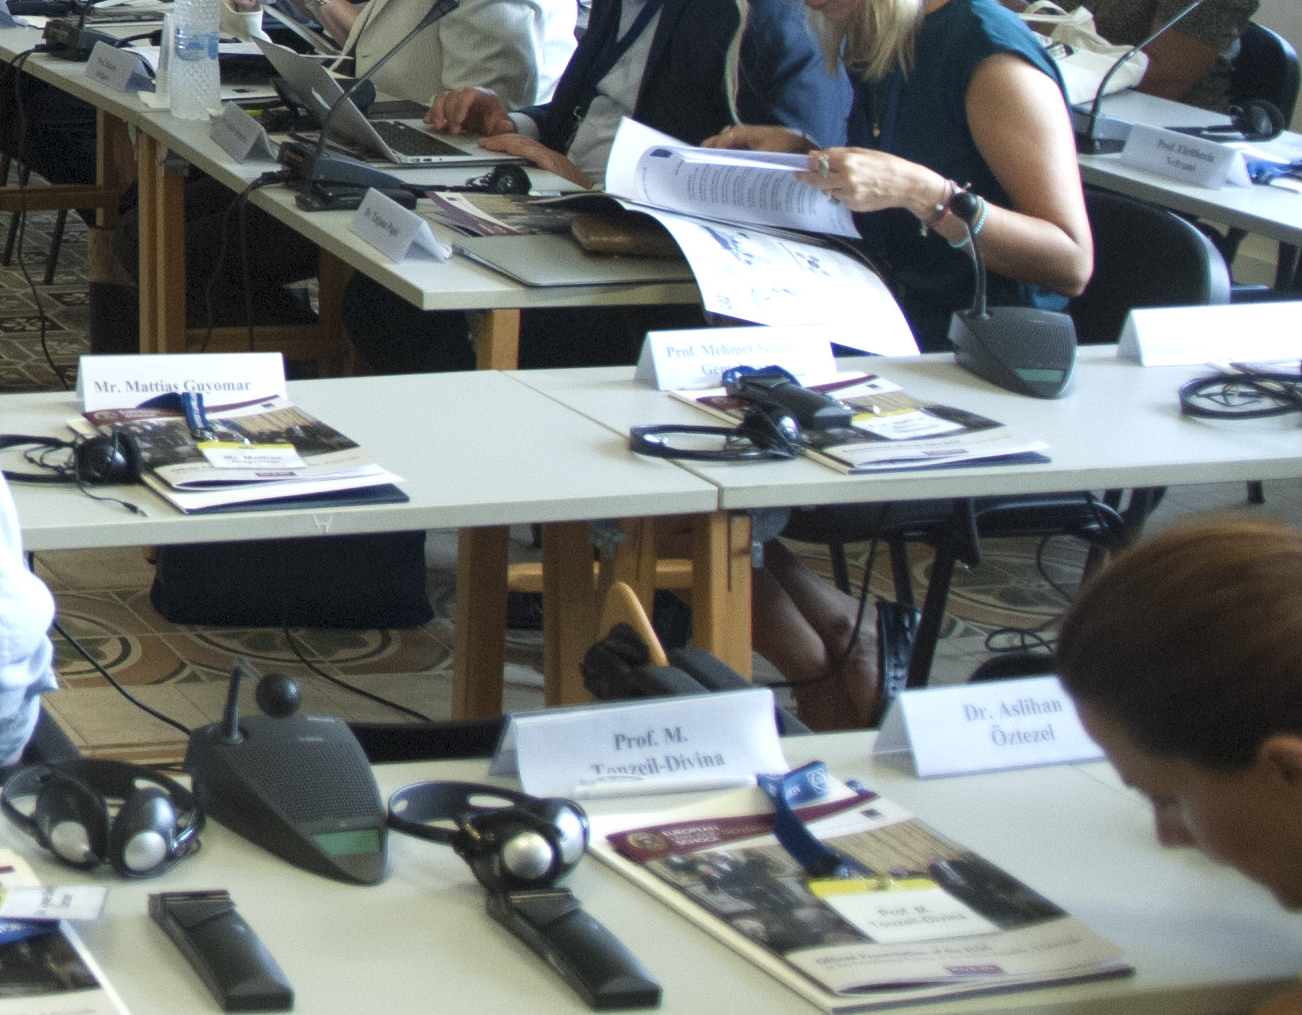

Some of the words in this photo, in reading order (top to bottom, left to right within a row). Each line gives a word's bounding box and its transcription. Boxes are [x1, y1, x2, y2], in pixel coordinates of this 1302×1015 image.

[666, 345, 698, 358] Prof.
[701, 343, 754, 357] Mehmet
[94, 380, 121, 393] Mr.
[125, 380, 179, 393] Mattias
[183, 380, 251, 395] Guyomar
[963, 704, 994, 722] Dr.
[614, 729, 658, 751] Prof.
[664, 726, 689, 745] M.
[991, 724, 1056, 747] Öztezel
